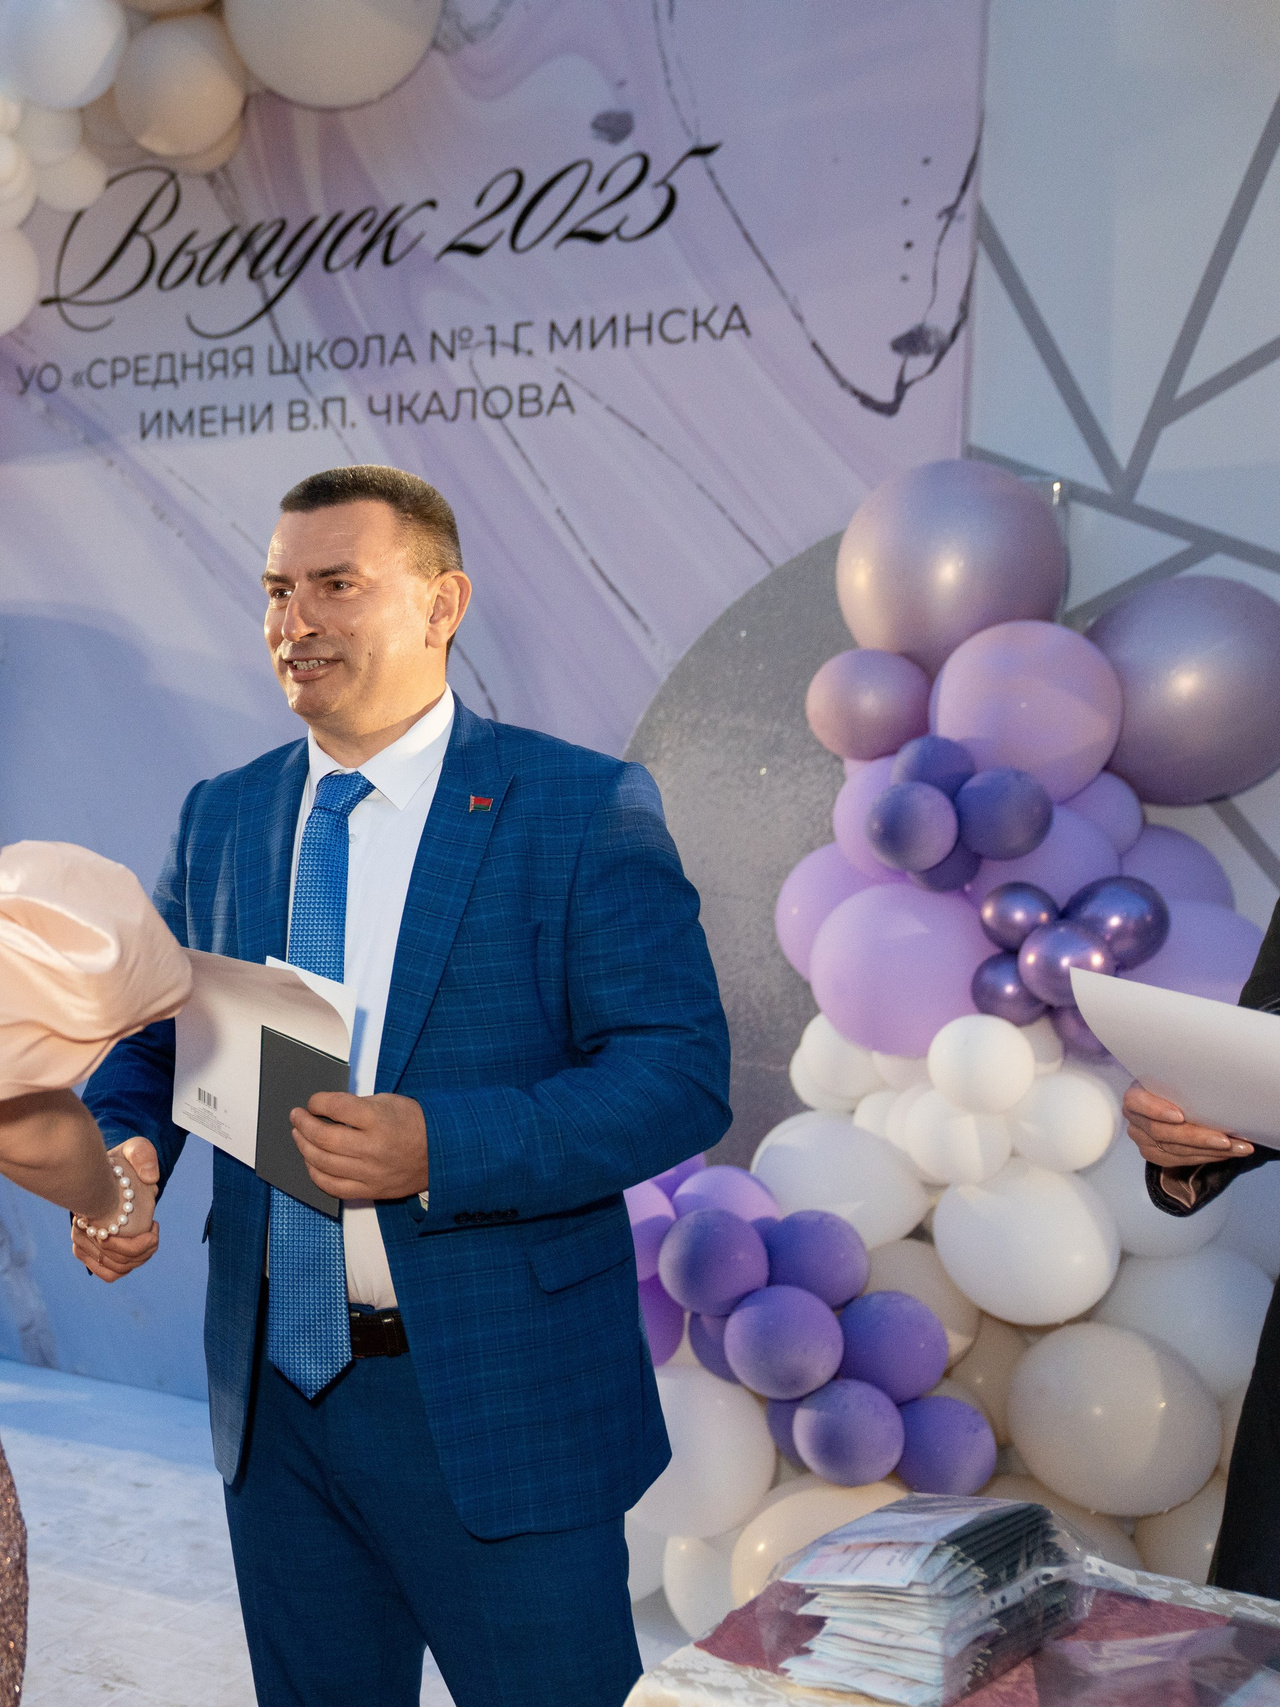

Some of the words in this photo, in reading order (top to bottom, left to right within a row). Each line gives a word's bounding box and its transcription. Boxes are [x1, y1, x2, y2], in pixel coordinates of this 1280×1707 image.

[40, 165, 437, 339] Выпуск
[435, 143, 722, 261] 2025
[16, 361, 62, 396] УО
[71, 345, 254, 390] «СРЕДНЯЯ
[268, 331, 417, 377] ШКОЛА
[513, 321, 535, 357] Г.
[548, 302, 752, 353] МИНСКА
[139, 402, 275, 440] ИМЕНИ
[287, 396, 357, 432] В.П.
[368, 381, 576, 426] ЧКАЛОВА
